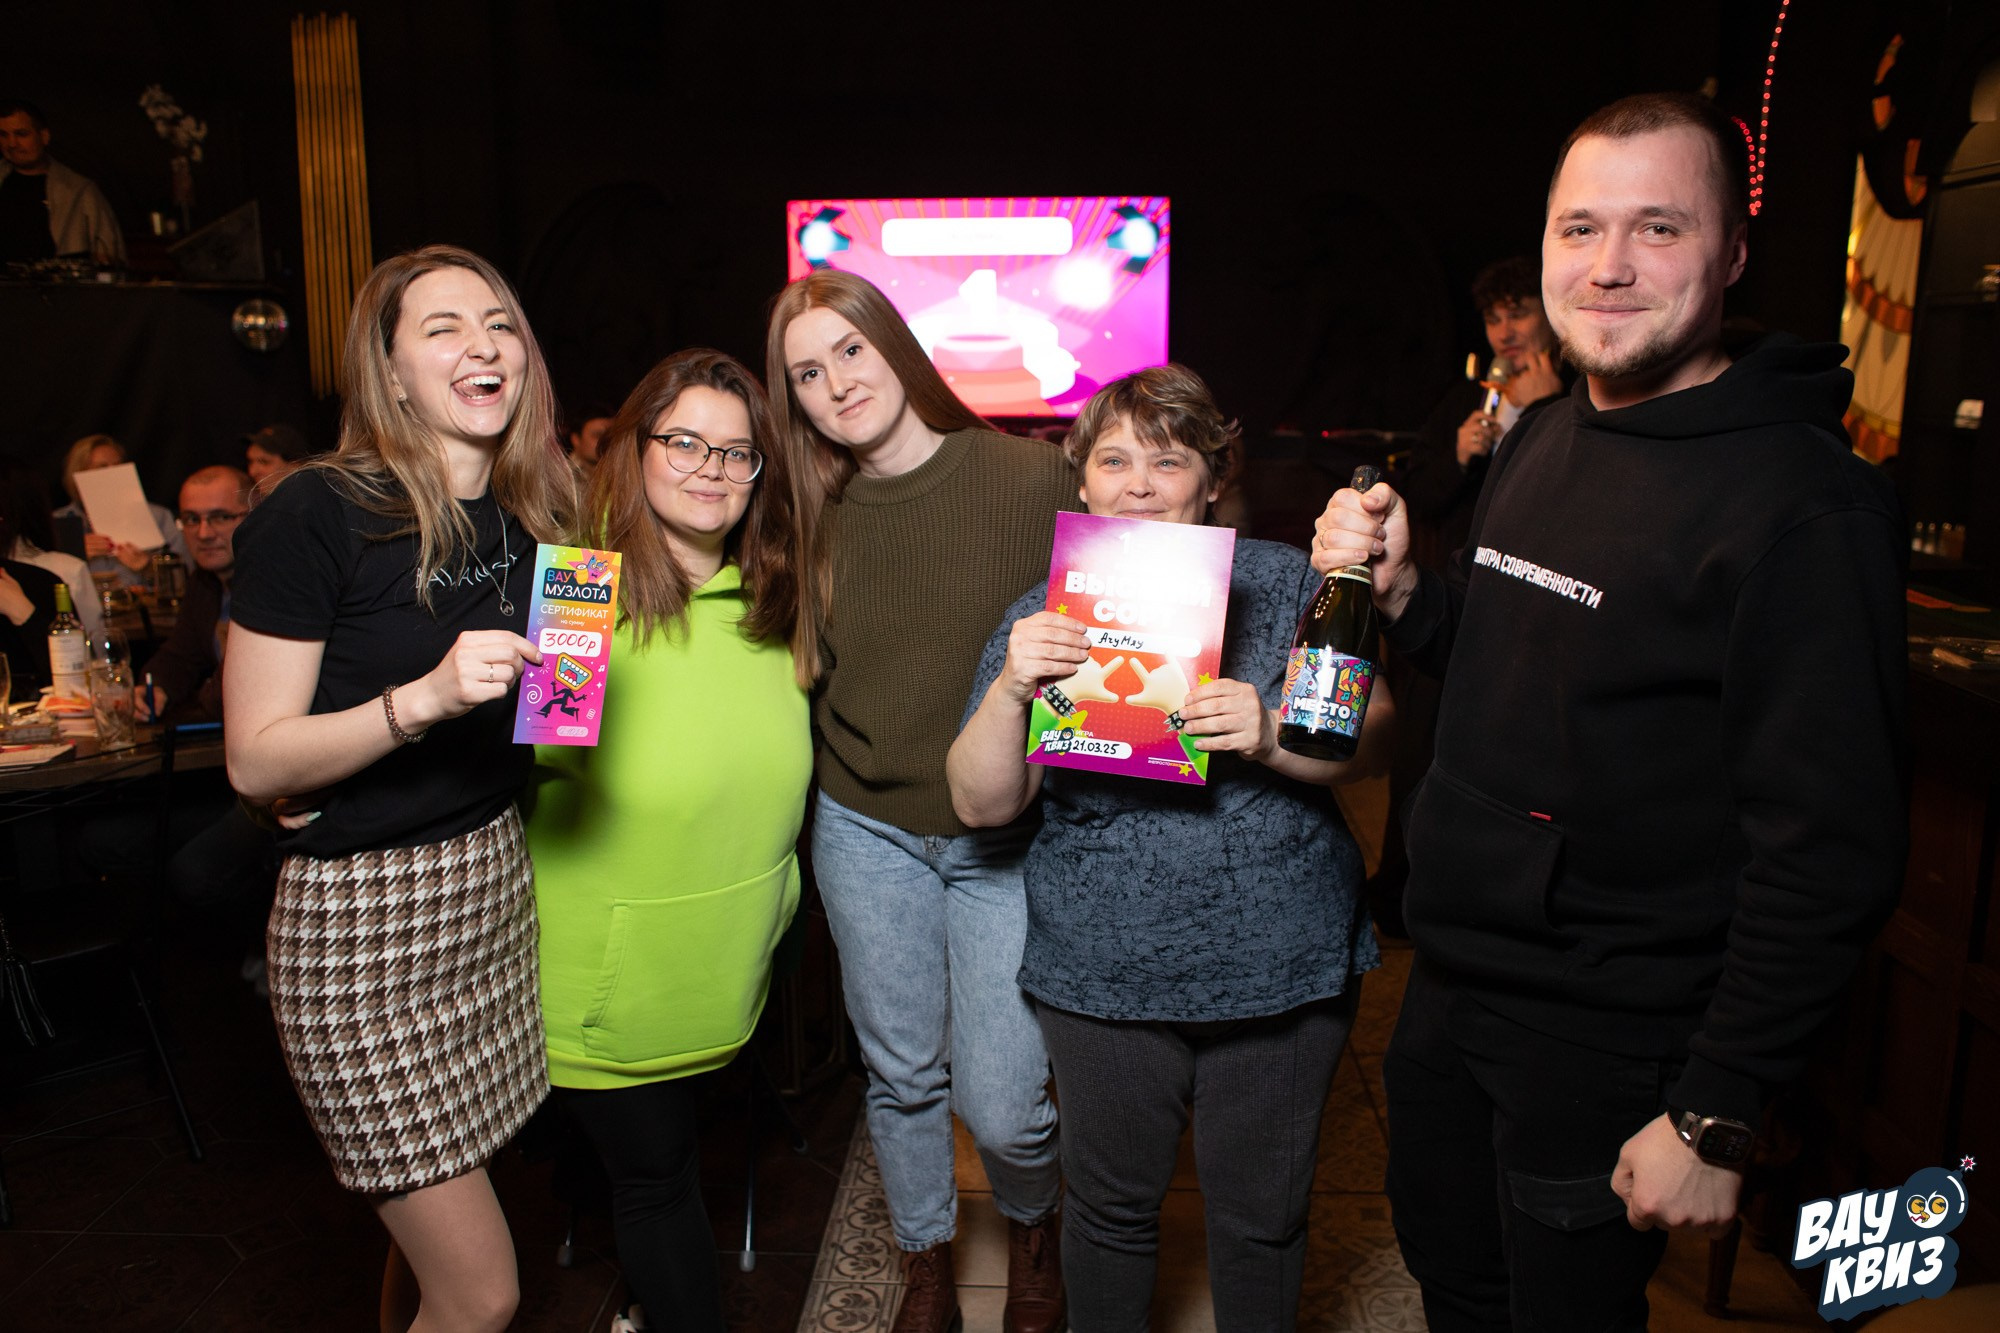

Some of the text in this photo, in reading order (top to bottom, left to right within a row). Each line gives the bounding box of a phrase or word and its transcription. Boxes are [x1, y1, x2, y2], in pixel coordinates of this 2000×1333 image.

[547, 570, 572, 583] ВАУ
[1500, 554, 1604, 609] СОВРЕМЕННОСТИ
[545, 583, 608, 601] МУЗЛОТА
[540, 604, 609, 619] СЕРТИФИКАТ
[1293, 696, 1351, 718] МЕСТО
[1040, 730, 1062, 743] ВАУ
[1075, 730, 1094, 738] ИГРА
[1044, 740, 1070, 752] КВИЗ
[1073, 740, 1120, 755] 21.03.25
